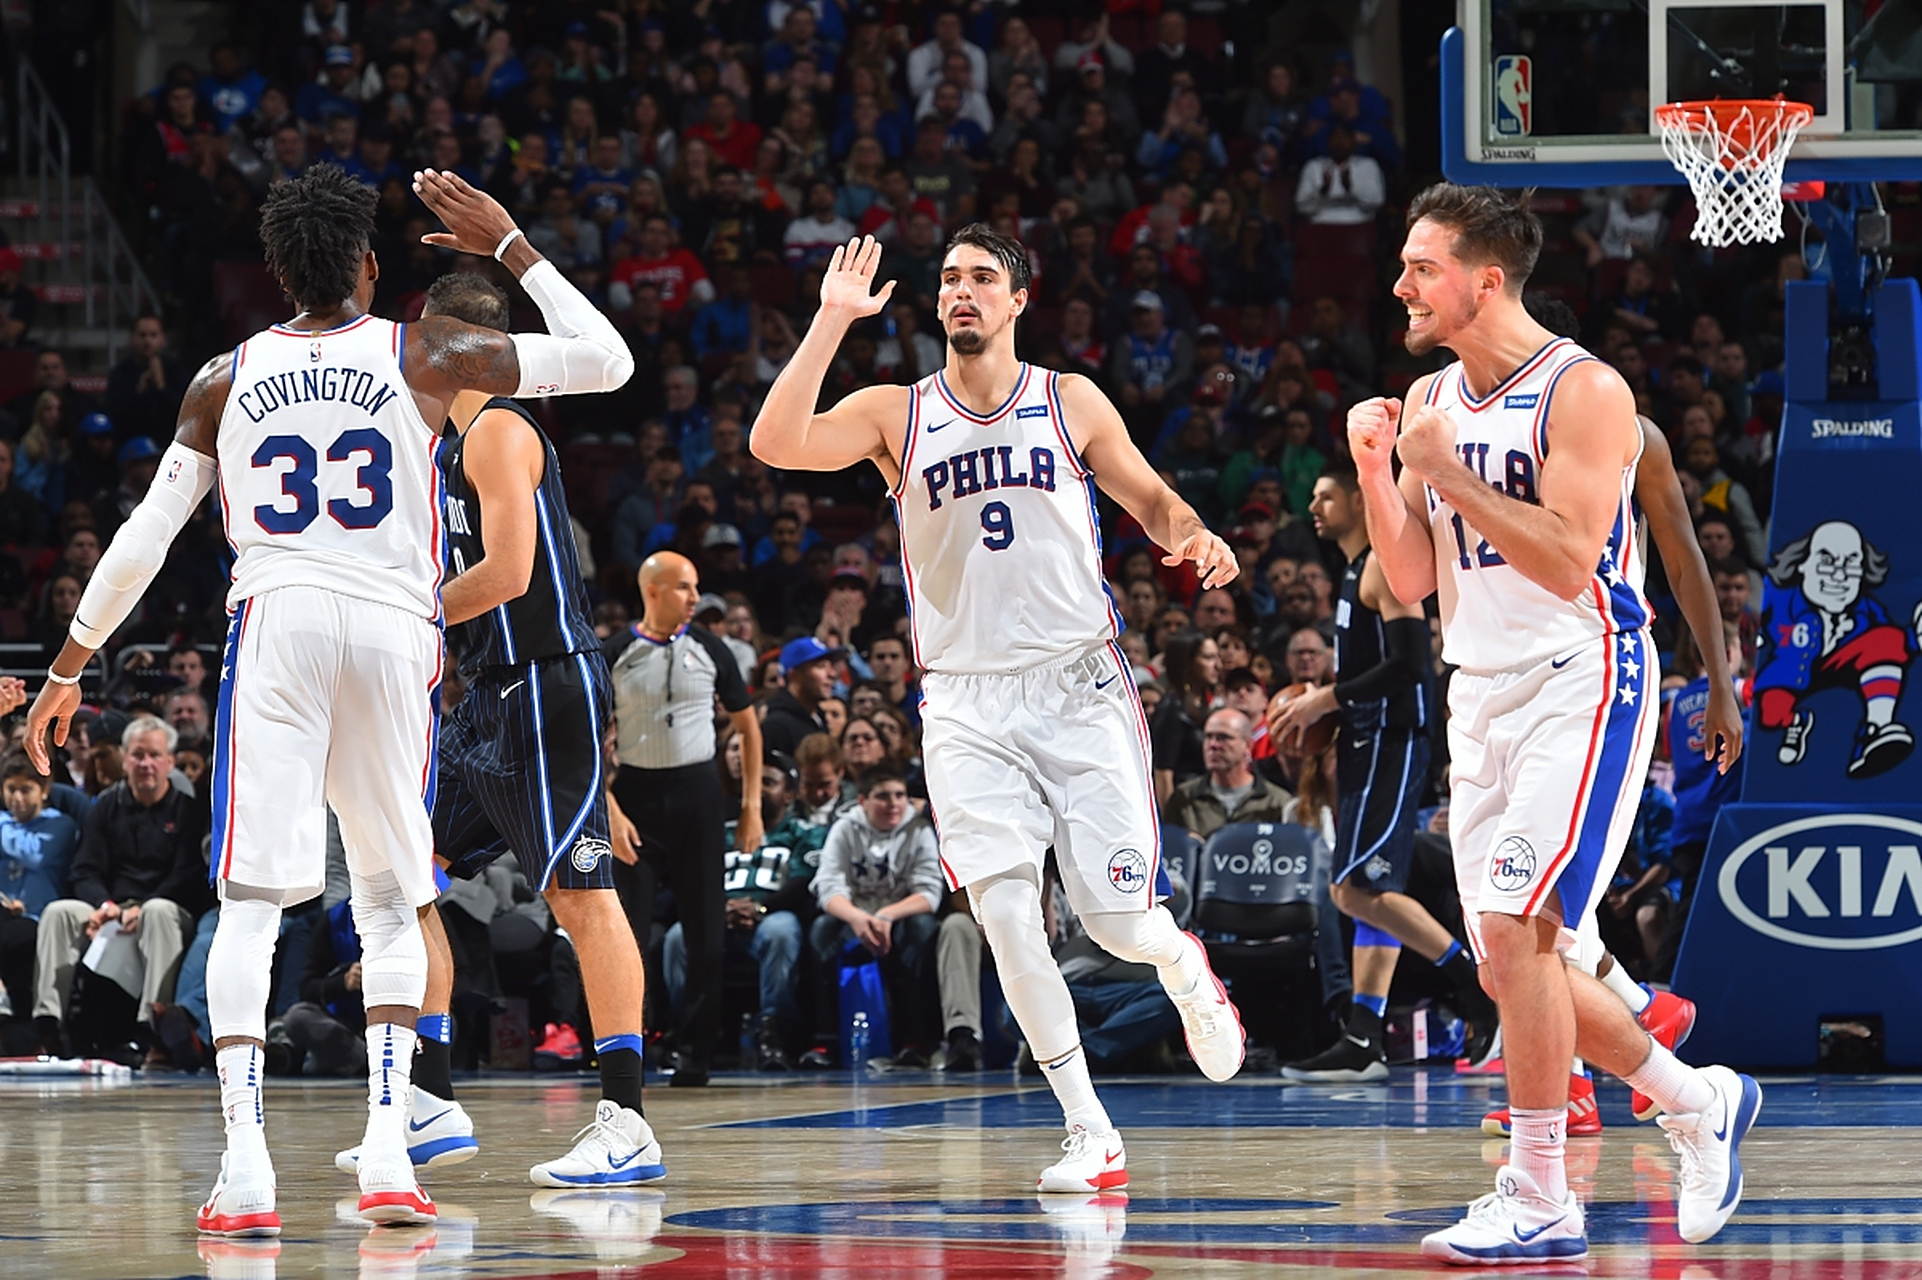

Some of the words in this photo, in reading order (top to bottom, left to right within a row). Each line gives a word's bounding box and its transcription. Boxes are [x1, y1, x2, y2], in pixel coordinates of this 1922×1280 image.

[1480, 147, 1536, 161] SPALDING
[238, 368, 397, 423] COVINGTON
[1812, 418, 1894, 439] SPALDING
[251, 427, 393, 535] 33
[922, 446, 1056, 511] PHILA
[1426, 442, 1541, 512] ILA
[980, 500, 1015, 551] 9
[1777, 622, 1809, 648] 76
[1213, 852, 1308, 876] VOMOS
[1764, 845, 1922, 918] KIA
